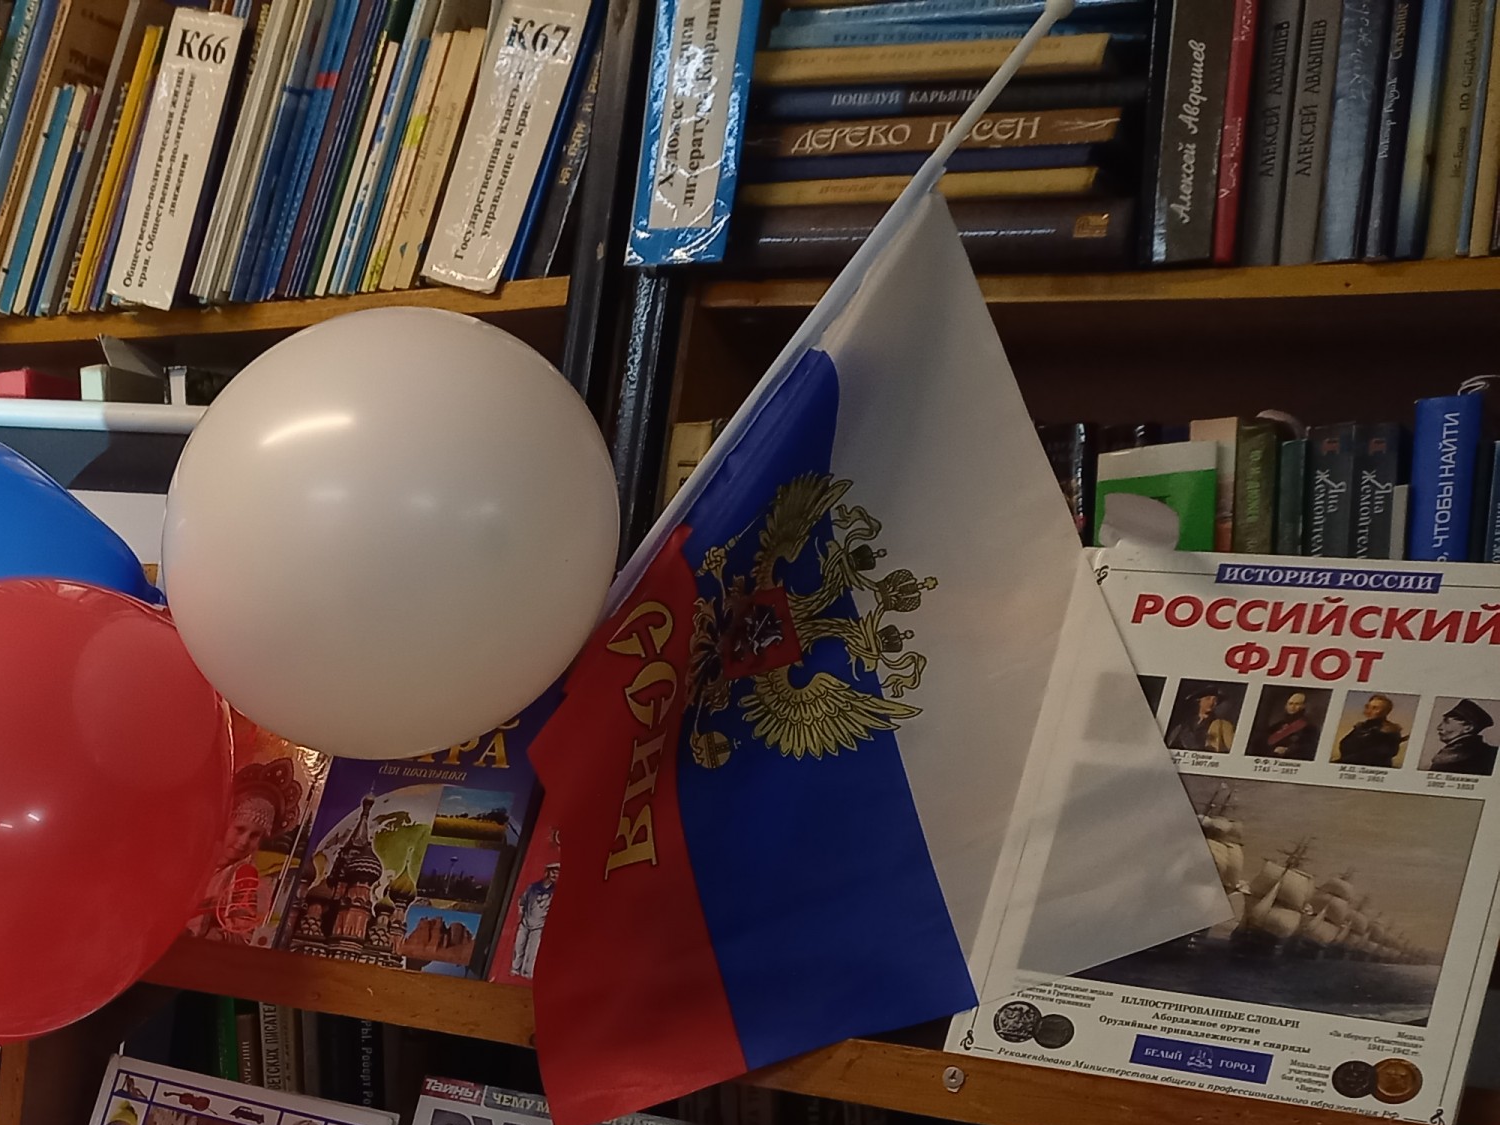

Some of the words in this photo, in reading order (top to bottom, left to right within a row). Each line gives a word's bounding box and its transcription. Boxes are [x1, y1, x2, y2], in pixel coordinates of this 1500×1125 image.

[176, 28, 231, 65] К66
[506, 17, 572, 57] К67
[1267, 20, 1291, 96] АВДЫШЕВ
[1304, 19, 1328, 95] АВДЫШЕВ
[1178, 38, 1210, 138] Авдышев
[791, 123, 912, 155] ДЕРЕВО
[926, 116, 1041, 145] ПСЕН
[1259, 104, 1283, 179] АЛЕКСЕЙ
[1295, 103, 1319, 178] АЛЕКСЕЙ
[168, 153, 189, 217] движения
[453, 133, 504, 261] Государственная
[1170, 142, 1197, 225] Алексей
[1438, 412, 1461, 478] НАЙТИ
[1432, 482, 1454, 549] ЧТОБЫ
[1222, 567, 1332, 587] ИСТОРИЯ
[1339, 571, 1438, 592] РОССИИ
[1130, 592, 1500, 647] РОССИЙСКИЙ
[1224, 642, 1385, 684] ФЛОТ
[1098, 1013, 1158, 1032] Орудийные
[1159, 1023, 1252, 1047] принадлежности
[1262, 1039, 1311, 1056] снаряды
[1120, 993, 1245, 1021] ИЛЛЮСТРИРОВАННЫЕ
[1245, 1012, 1301, 1030] СЛОВАРИ
[1151, 1011, 1218, 1030] Абордажное
[1219, 1021, 1262, 1036] оружие
[997, 1047, 1072, 1067] Рекомендовано
[1072, 1059, 1160, 1082] Министерством
[1160, 1074, 1197, 1089] общего
[1206, 1081, 1310, 1109] профессионального
[1144, 1046, 1183, 1061] БЕЛЫЙ
[1219, 1059, 1256, 1075] ГОРОД
[492, 1091, 536, 1111] ЧЕМУ
